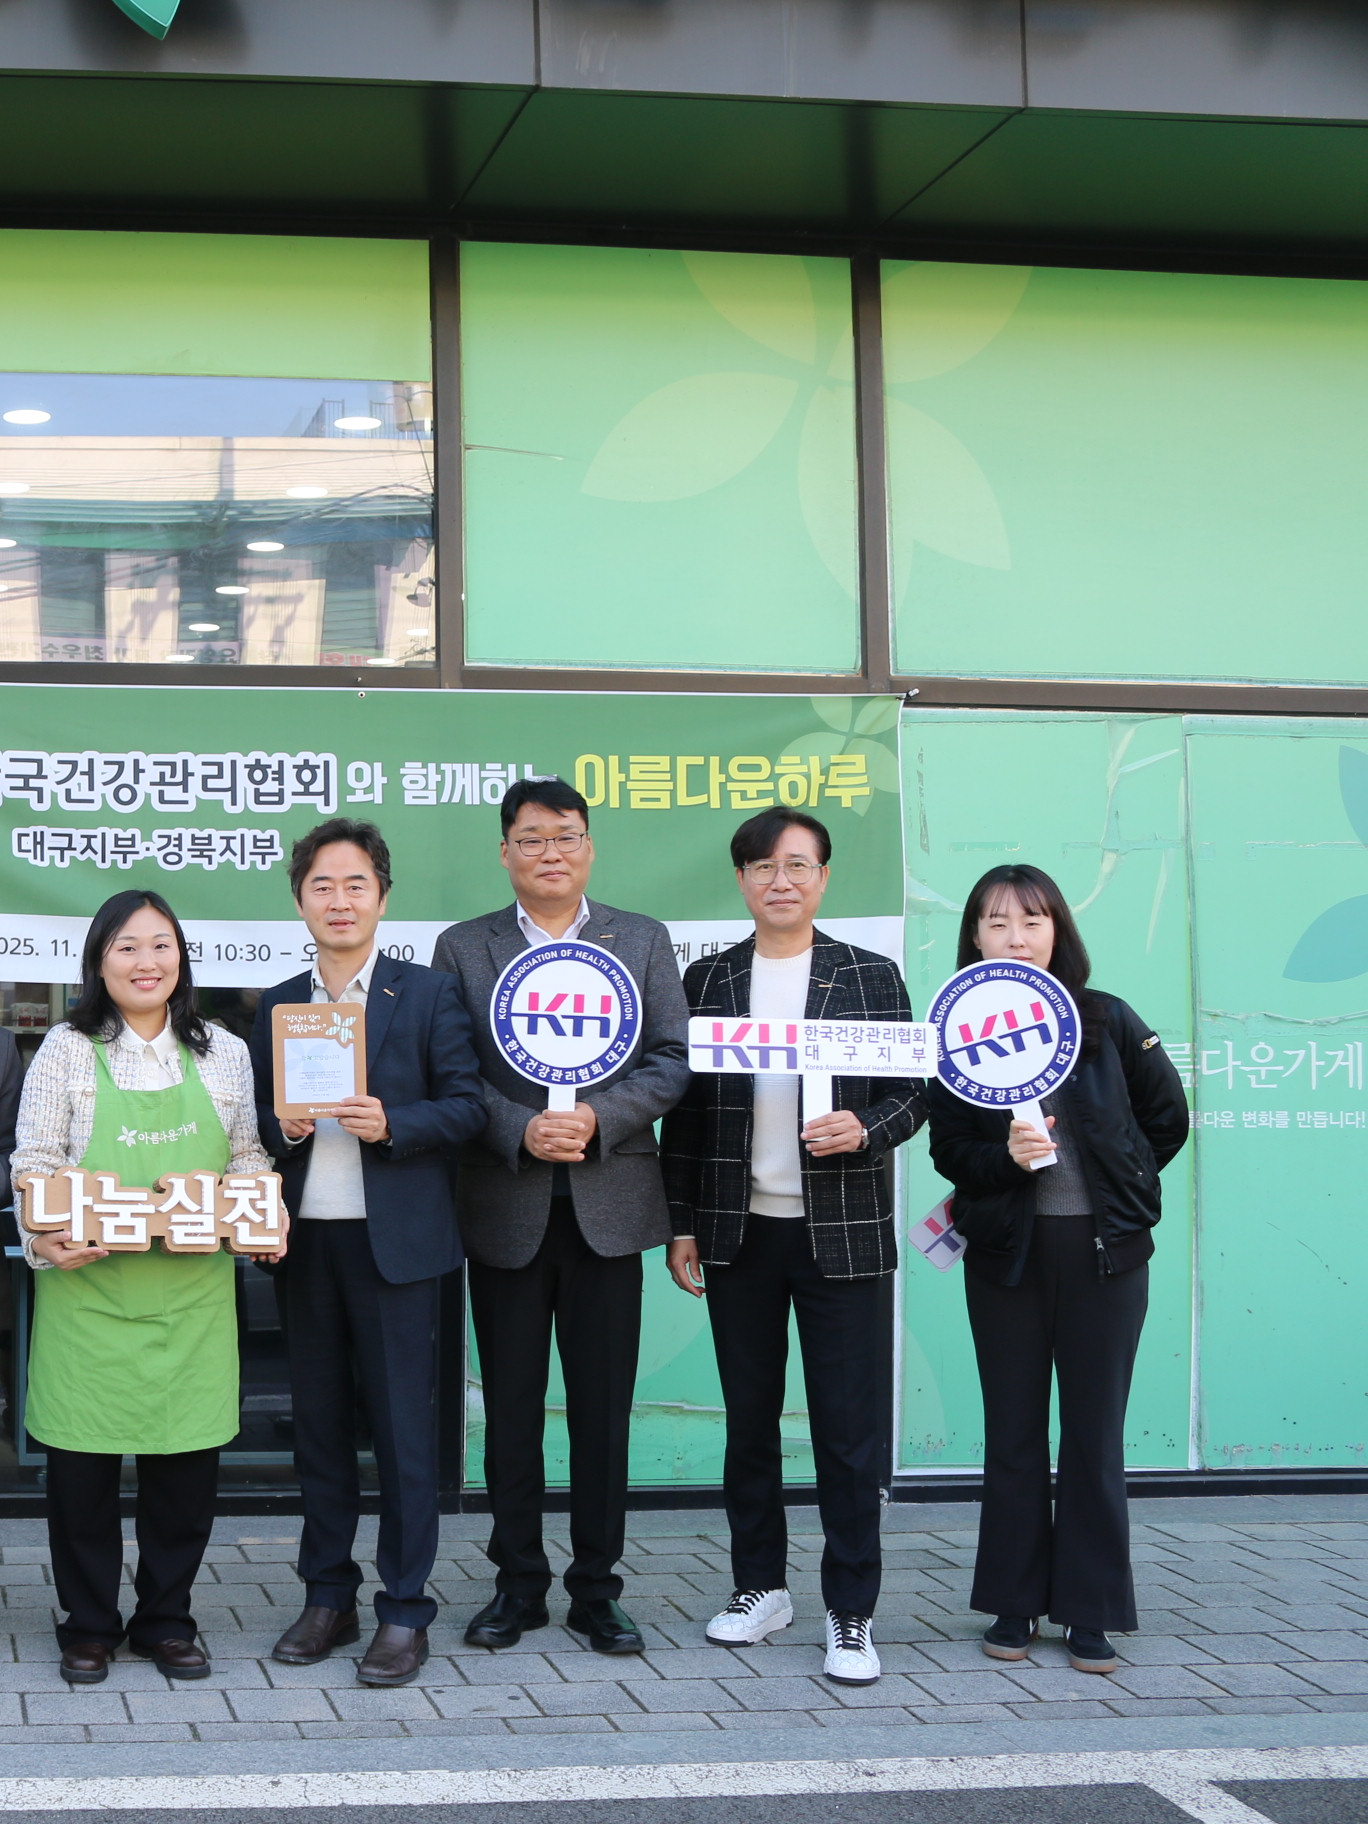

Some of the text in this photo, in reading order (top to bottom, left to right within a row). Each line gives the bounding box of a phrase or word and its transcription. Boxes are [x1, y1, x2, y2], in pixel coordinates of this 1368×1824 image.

[346, 760, 388, 805] 와
[574, 752, 871, 810] 아름다운하루
[50, 938, 78, 958] 11.
[214, 943, 272, 963] 10:30
[498, 949, 634, 1020] KOREA ASSOCIATION OF HEALTH PROMOTION
[974, 970, 987, 982] OF
[989, 968, 1028, 980] HEALTH
[1029, 975, 1069, 1020] PROMOTION
[511, 992, 612, 1039] KH
[804, 1024, 927, 1044] 한국건강관리협회
[947, 1001, 1053, 1067] KH
[505, 1039, 628, 1083] 한국건강관리협회 대구
[690, 1022, 798, 1070] KH
[804, 1063, 824, 1071] Korea
[825, 1064, 862, 1072] Association
[863, 1064, 871, 1072] of
[894, 1065, 927, 1073] Promotion
[1164, 1040, 1364, 1091] 름다운가게
[953, 1040, 1075, 1103] 한국건강관리협회 대구
[1189, 1110, 1366, 1129] 름다운 변화를 만듭니다!
[26, 1170, 281, 1246] 나눔실천
